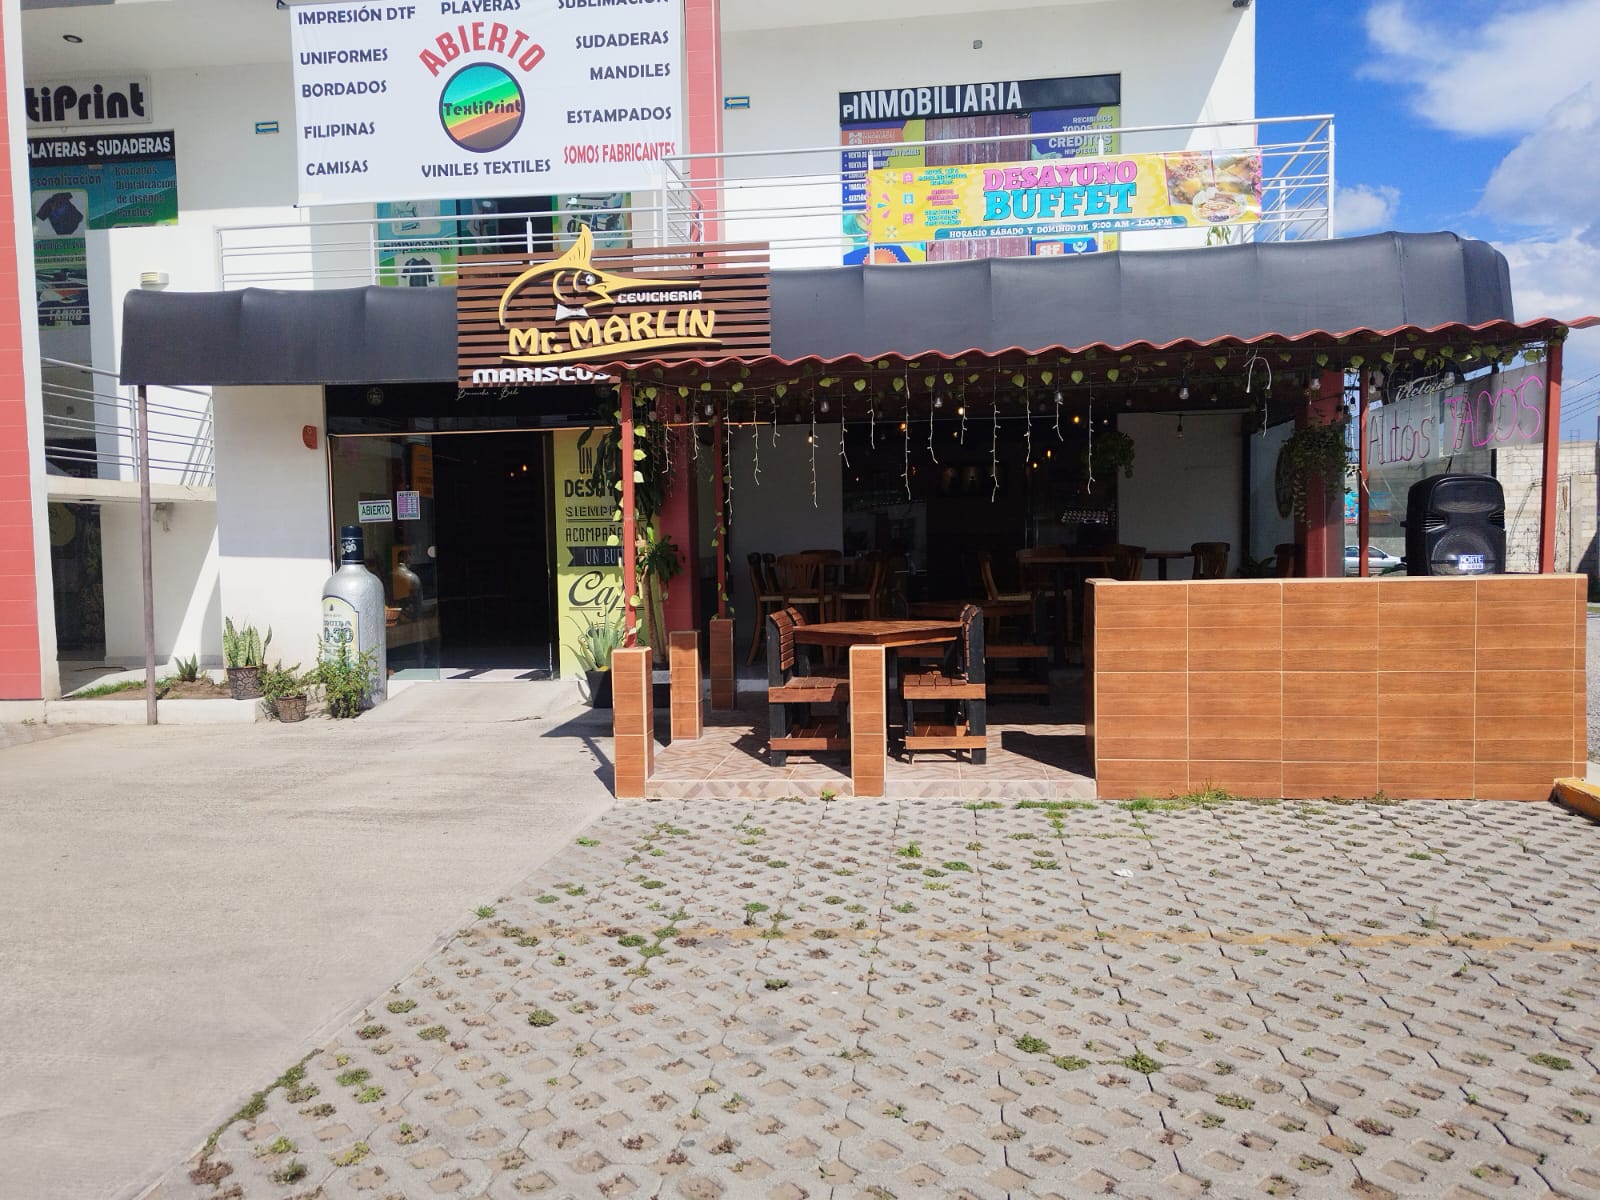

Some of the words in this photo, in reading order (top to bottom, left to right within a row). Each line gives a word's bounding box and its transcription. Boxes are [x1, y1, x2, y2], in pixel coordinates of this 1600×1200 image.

[298, 6, 382, 25] IMPRESIÓN
[386, 6, 416, 21] DTF
[441, 0, 521, 15] PLAYERAS
[576, 30, 669, 49] SUDADERAS
[300, 48, 388, 65] UNIFORMES
[419, 21, 545, 77] ABIERTO
[590, 63, 671, 80] MANDILES
[302, 80, 387, 98] BORDADOS
[443, 99, 521, 116] TextiPrint
[567, 106, 672, 124] ESTAMPADOS
[304, 122, 375, 139] FILIPINAS
[97, 137, 171, 156] SUDADERAS
[564, 145, 600, 164] SOMOS
[602, 142, 676, 163] FABRICANTES
[306, 160, 369, 176] CAMISAS
[421, 162, 479, 178] VINILES
[484, 159, 551, 175] TEXTILES
[983, 161, 1138, 190] DESAYUNO
[983, 182, 1138, 222] BUFFET
[949, 229, 987, 239] HORARIO
[1028, 226, 1033, 234] Y
[1036, 224, 1077, 234] DOMINGO
[1077, 224, 1089, 232] DE
[1091, 221, 1112, 230] 9:00
[1114, 220, 1130, 228] AM
[617, 290, 702, 305] CEVICHERIA
[508, 328, 563, 356] Mr.
[569, 310, 716, 350] MARLIN
[1443, 375, 1544, 449] TACOS
[361, 504, 390, 516] ABIERTO
[585, 548, 600, 566] UN
